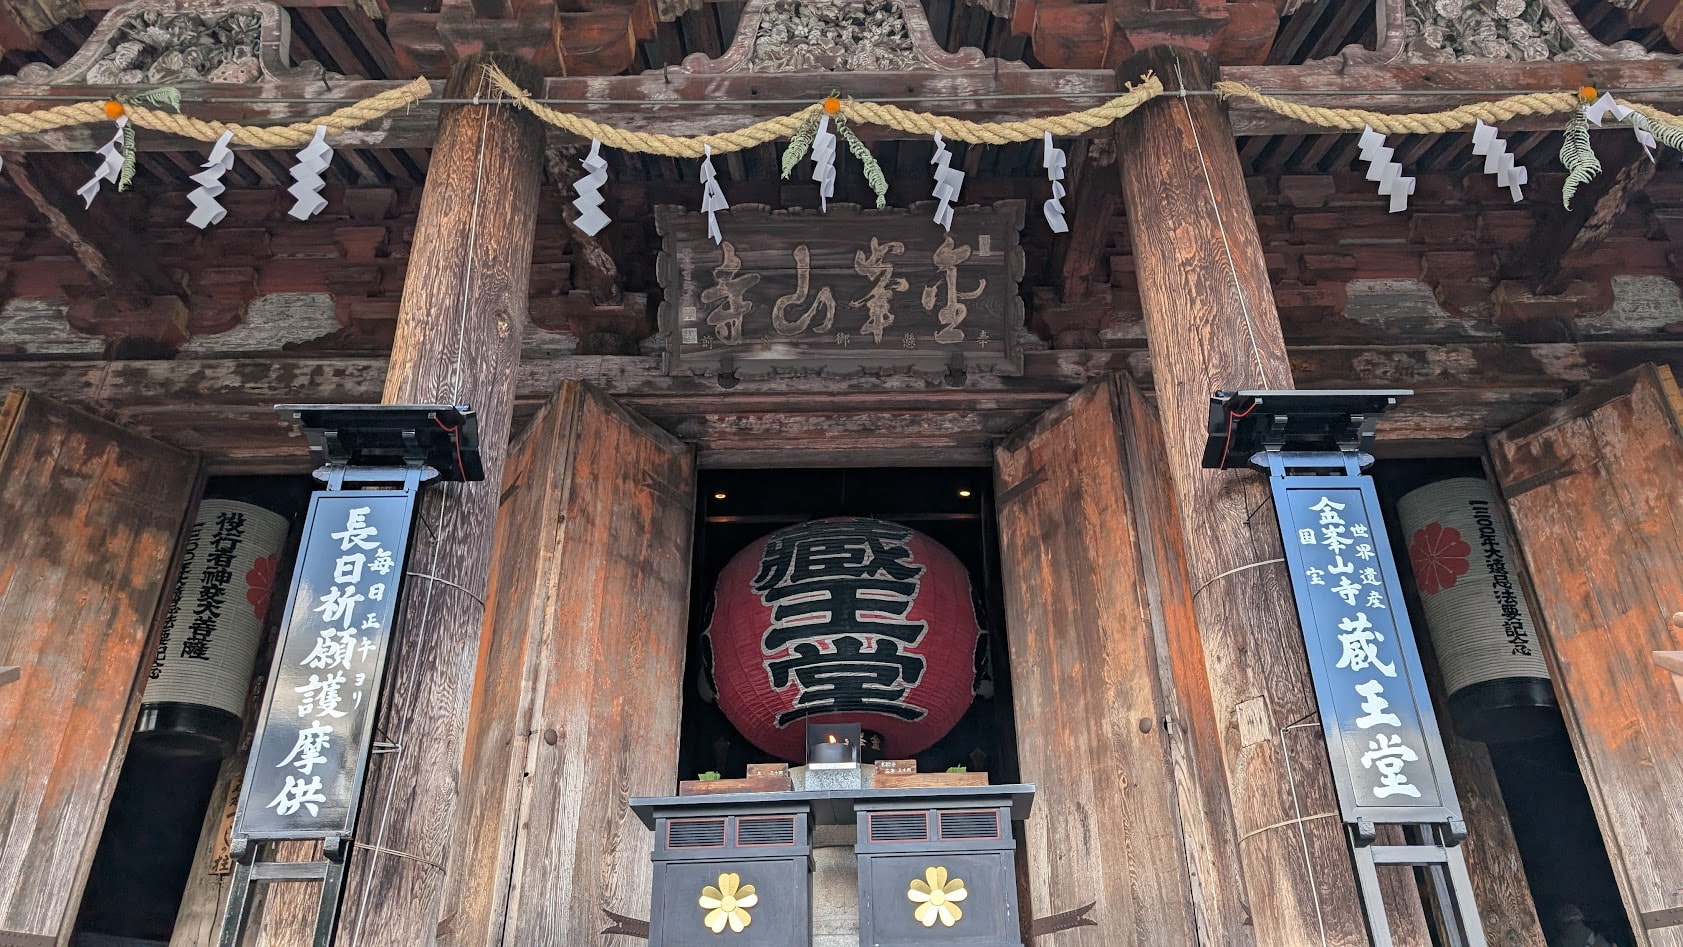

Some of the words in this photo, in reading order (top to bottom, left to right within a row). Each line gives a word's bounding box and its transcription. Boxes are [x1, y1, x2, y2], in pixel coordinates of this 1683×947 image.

[1299, 528, 1326, 585] 国宝
[1350, 523, 1386, 609] 世界遺産
[266, 506, 381, 817] 長日祈願護摩供
[353, 548, 394, 710] 毎日正午ヨリ
